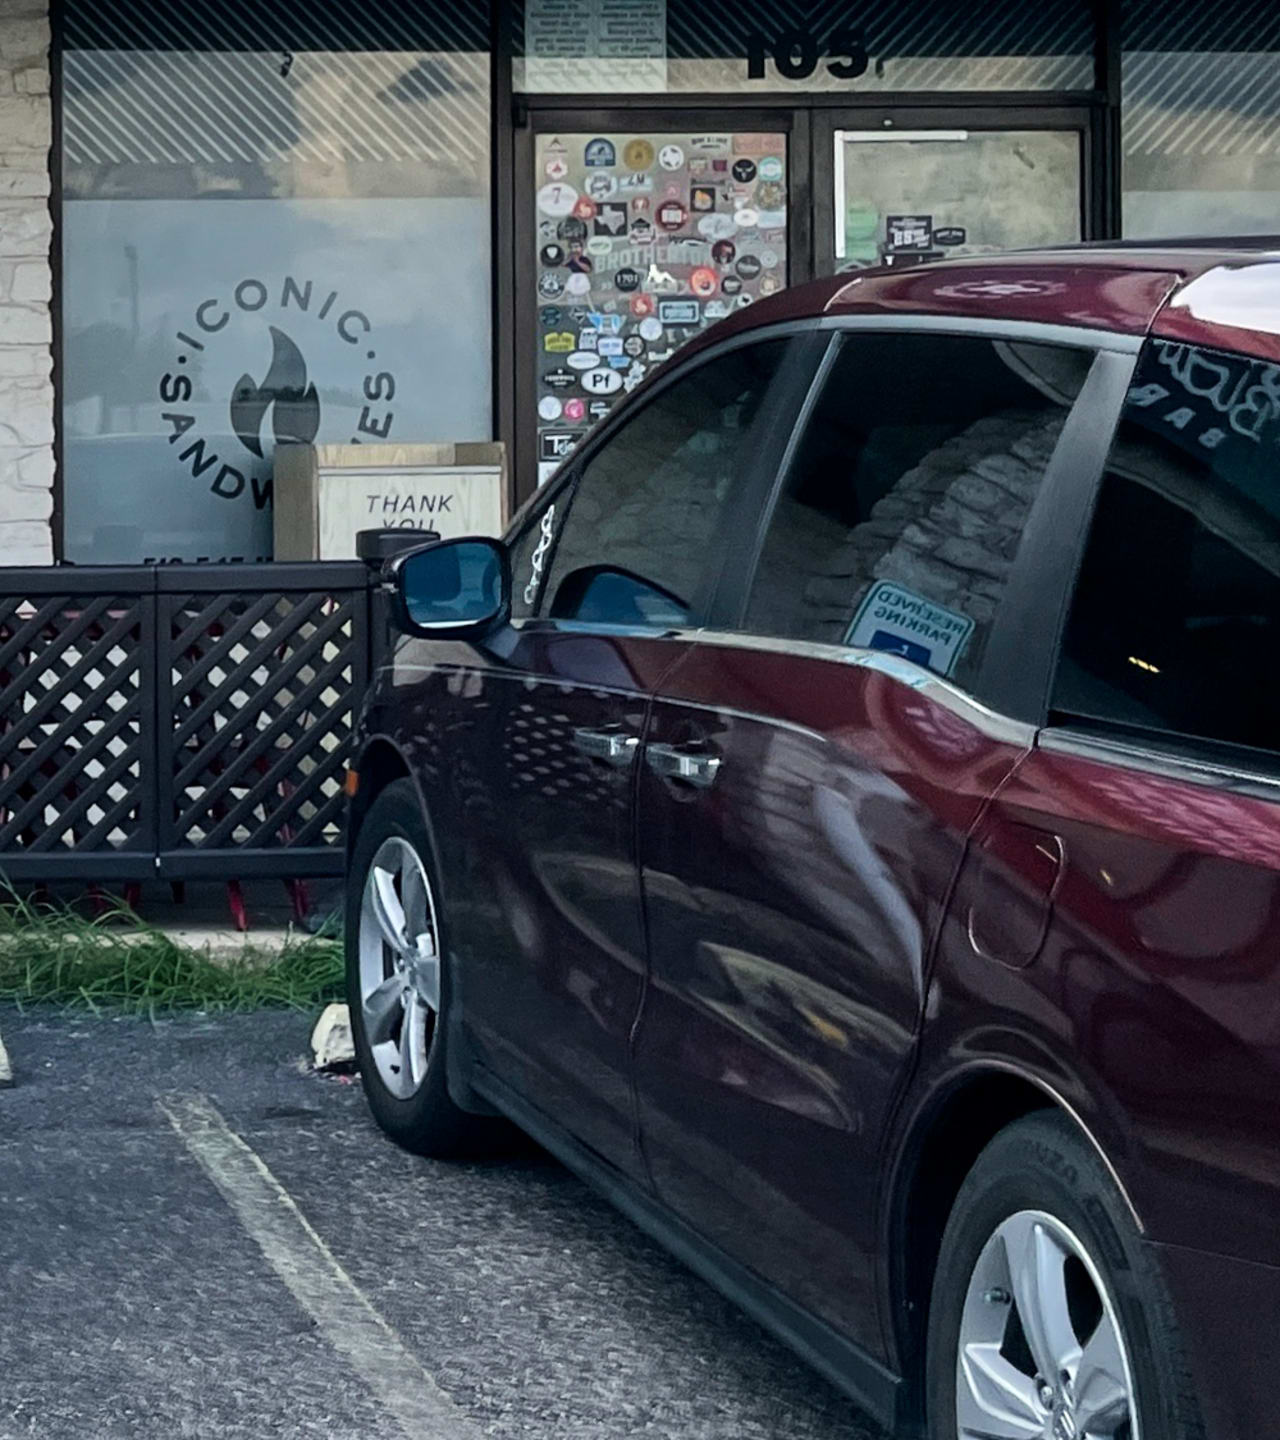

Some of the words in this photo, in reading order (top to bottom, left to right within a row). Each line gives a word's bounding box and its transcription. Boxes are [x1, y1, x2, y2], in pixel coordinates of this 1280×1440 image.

[177, 276, 371, 351] ICONIC
[592, 374, 611, 388] Pf
[159, 371, 396, 510] SANDWES
[366, 494, 454, 513] THANK
